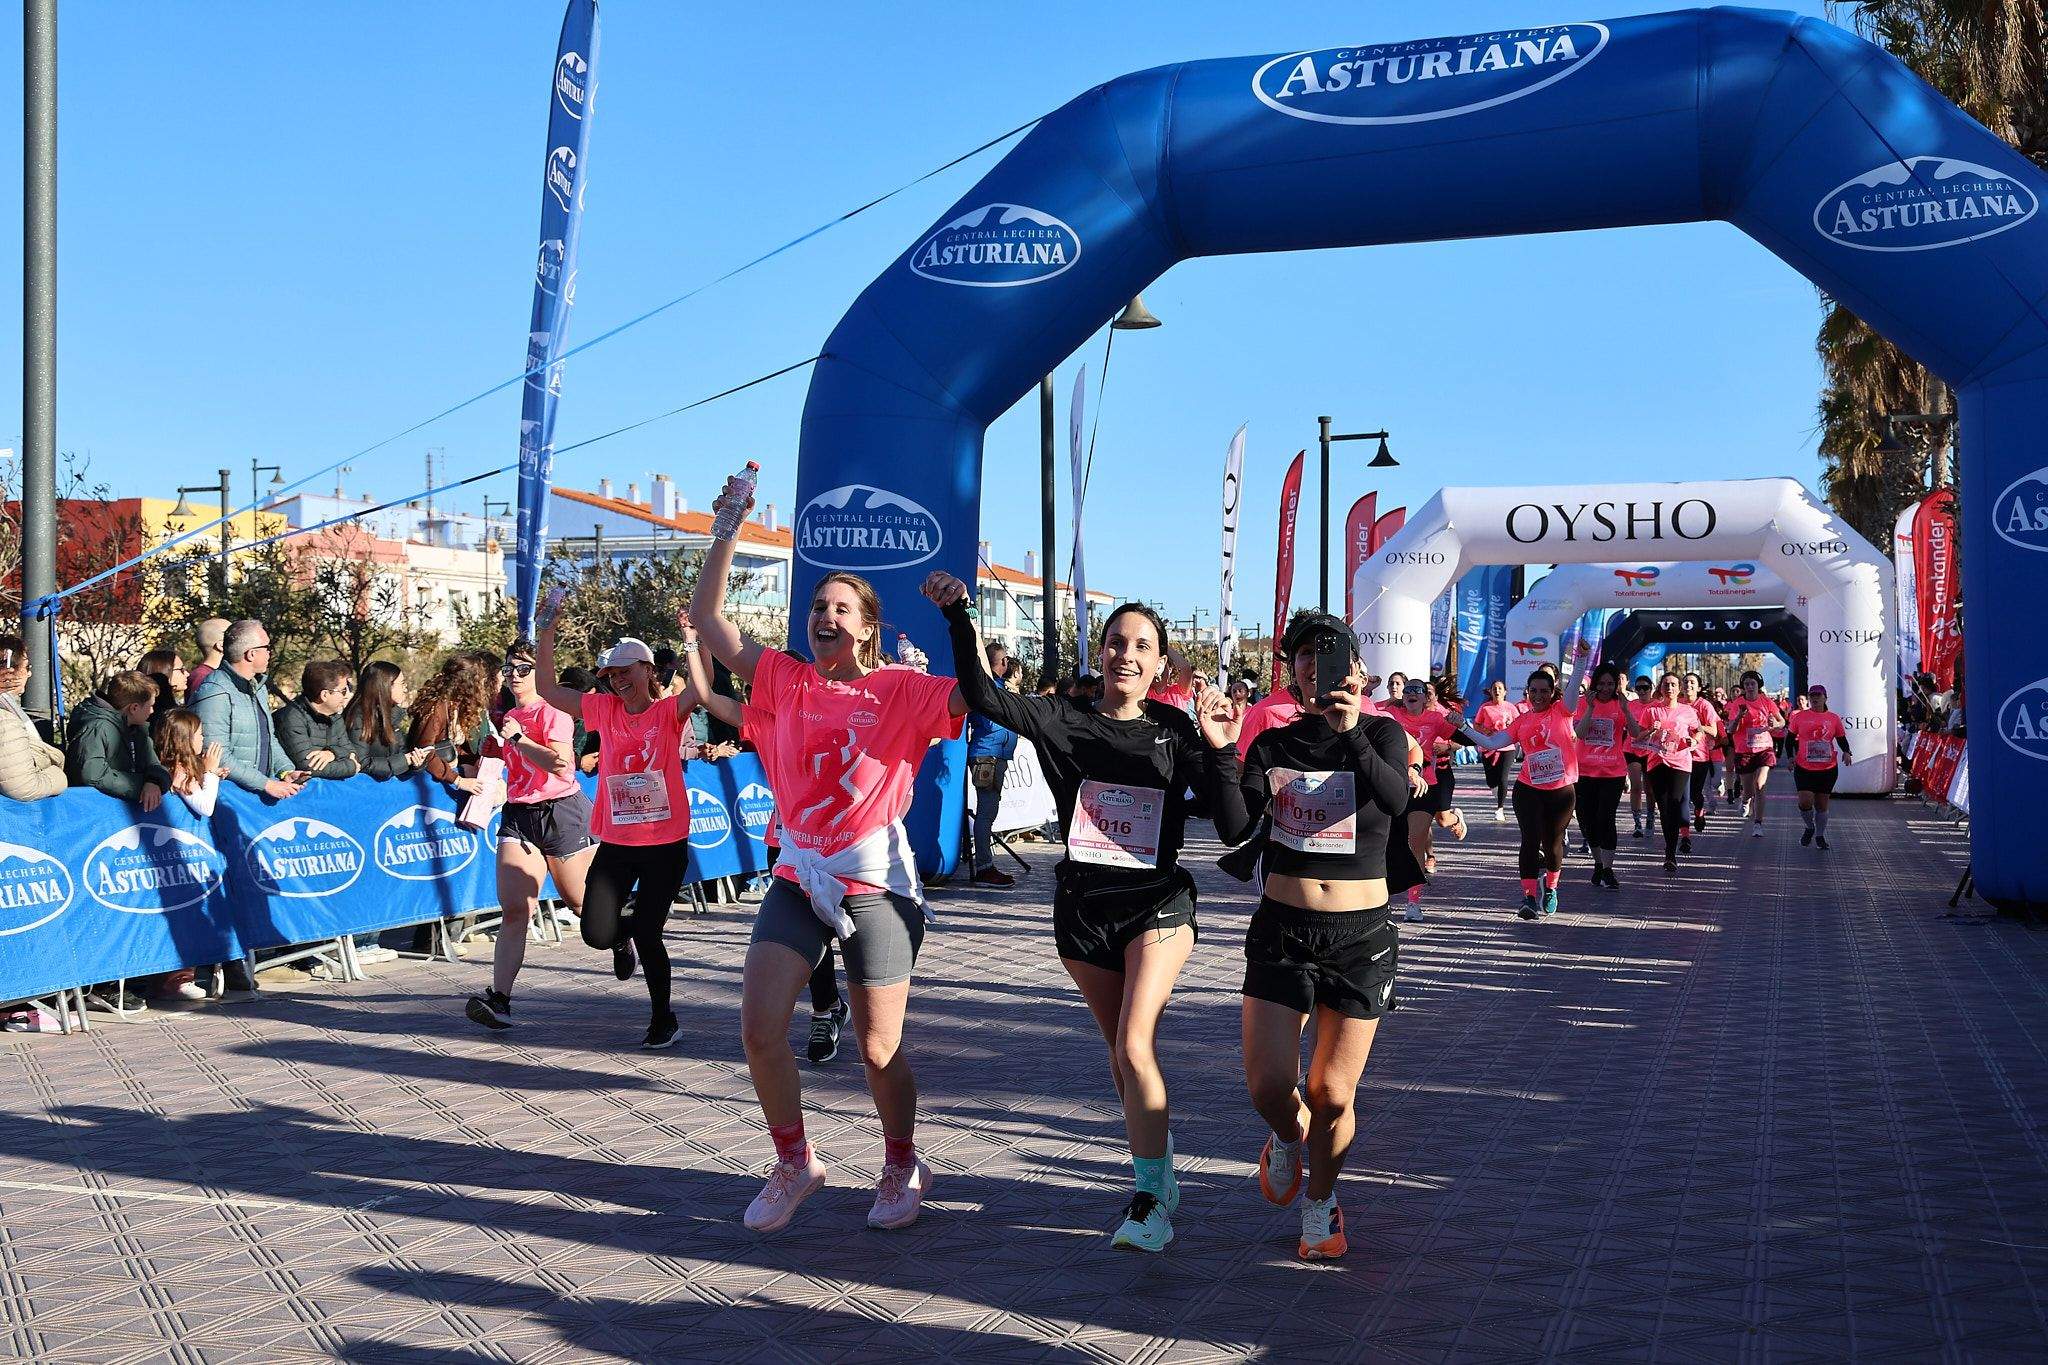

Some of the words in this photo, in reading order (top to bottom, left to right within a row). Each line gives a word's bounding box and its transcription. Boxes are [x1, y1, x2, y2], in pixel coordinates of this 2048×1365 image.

[1336, 41, 1447, 59] CENTRAL
[1457, 25, 1571, 46] LECHERA
[1275, 34, 1579, 98] ASTURIANA
[1862, 188, 1935, 204] CENTRAL
[1942, 182, 2012, 194] LECHERA
[1831, 194, 2025, 235] ASTURIANA
[946, 230, 998, 242] CENTRAL
[1003, 229, 1061, 239] LECHERA
[917, 240, 1067, 268] ASTURIANA
[815, 514, 864, 523] CENTRAL
[869, 515, 926, 526] LECHERA
[1505, 499, 1717, 544] OYSHO
[800, 516, 930, 552] ASTURIANA
[1781, 541, 1848, 556] OYSHO
[1385, 552, 1445, 565] OYSHO
[1929, 518, 1948, 615] Santander
[1614, 590, 1661, 598] TotalEnergies
[1708, 588, 1756, 596] TotalEnergies
[1657, 620, 1762, 631] VOLVO
[1358, 632, 1412, 645] OYSHO
[1819, 629, 1882, 644] OYSHO
[629, 795, 651, 804] 016
[1293, 806, 1327, 822] 016
[1097, 818, 1132, 834] 016
[383, 835, 472, 866] ASTURIANA
[257, 850, 357, 881] ASTURIANA
[98, 860, 216, 896] ASTURIANA
